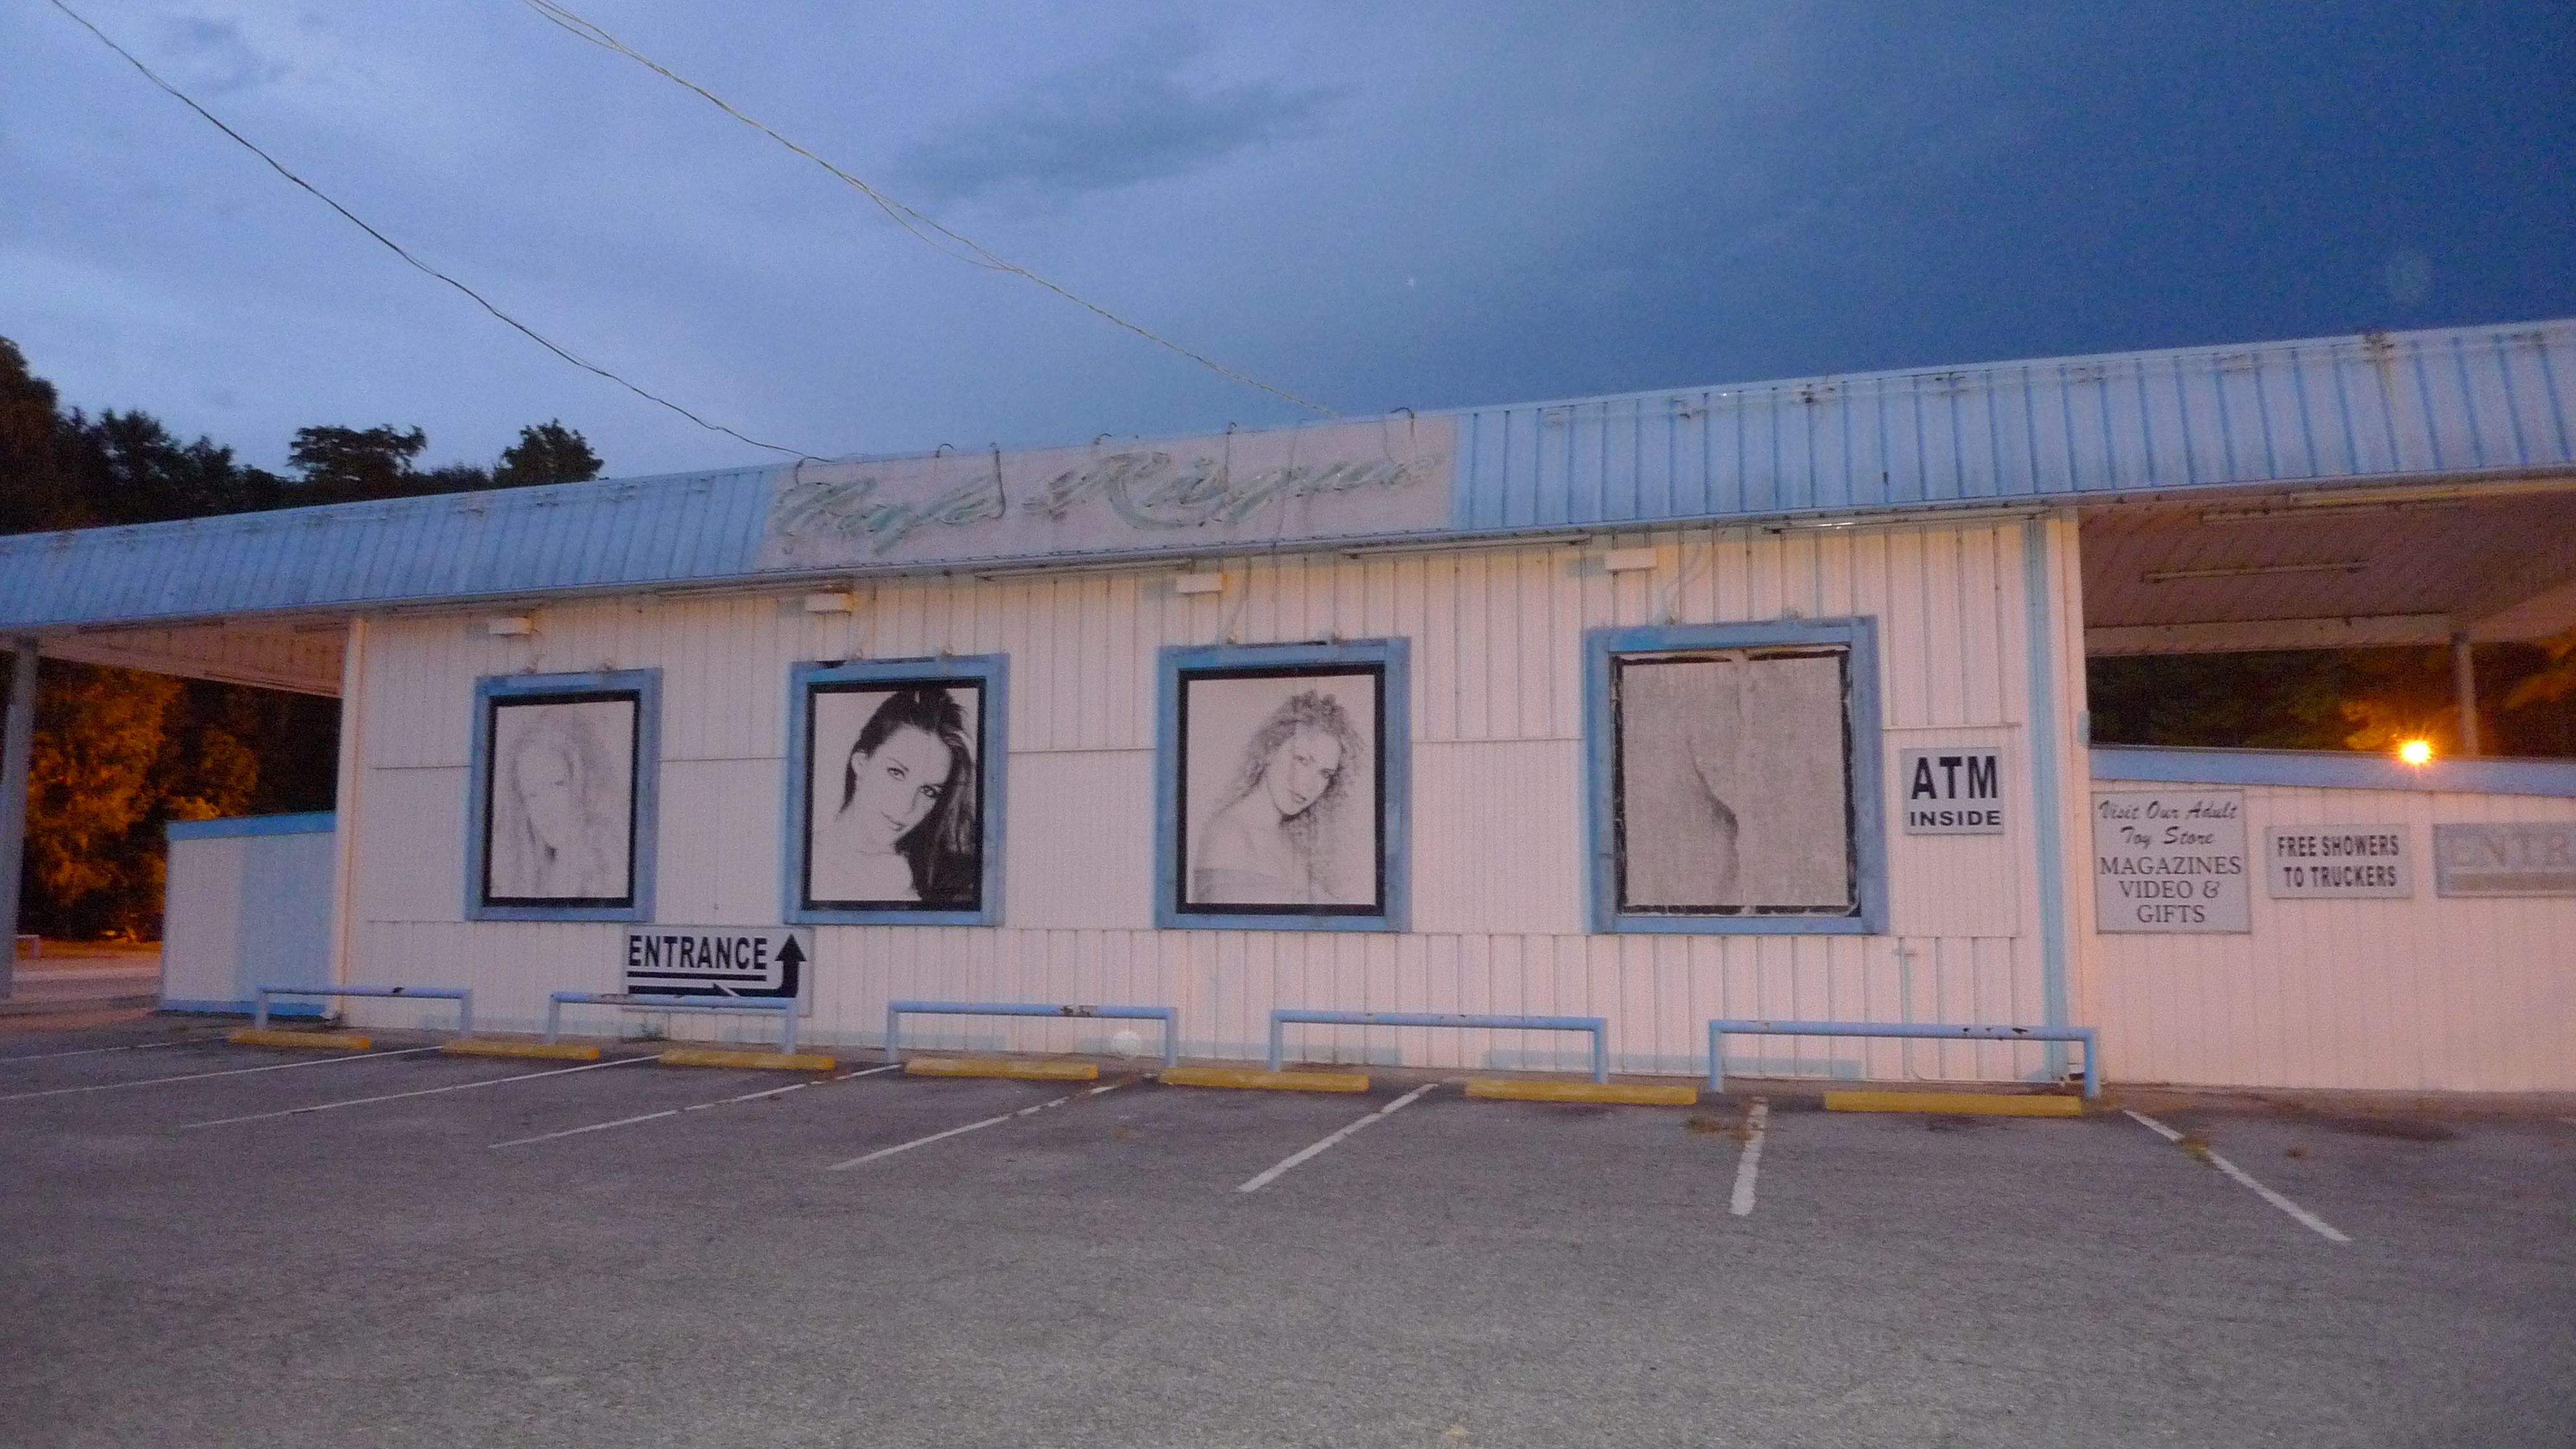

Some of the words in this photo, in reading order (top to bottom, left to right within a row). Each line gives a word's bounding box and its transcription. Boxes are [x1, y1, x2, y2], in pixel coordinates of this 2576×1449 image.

[1911, 756, 1998, 799] ATM
[1910, 811, 2001, 826] INSIDE
[2098, 800, 2140, 819] Visit
[2146, 800, 2179, 819] Our
[2186, 800, 2238, 819] Adult
[2120, 826, 2151, 849] Toy
[2163, 826, 2214, 844] Store
[2277, 836, 2316, 857] FREE
[2322, 835, 2399, 856] SHOWERS
[2099, 856, 2242, 874] MAGAZINES
[2283, 866, 2305, 887] TO
[2309, 865, 2397, 887] TRUCKERS
[2118, 880, 2194, 898] VIDEO
[2203, 880, 2220, 898] &
[2137, 905, 2205, 923] GIFTS
[628, 934, 767, 970] ENTRANCE
